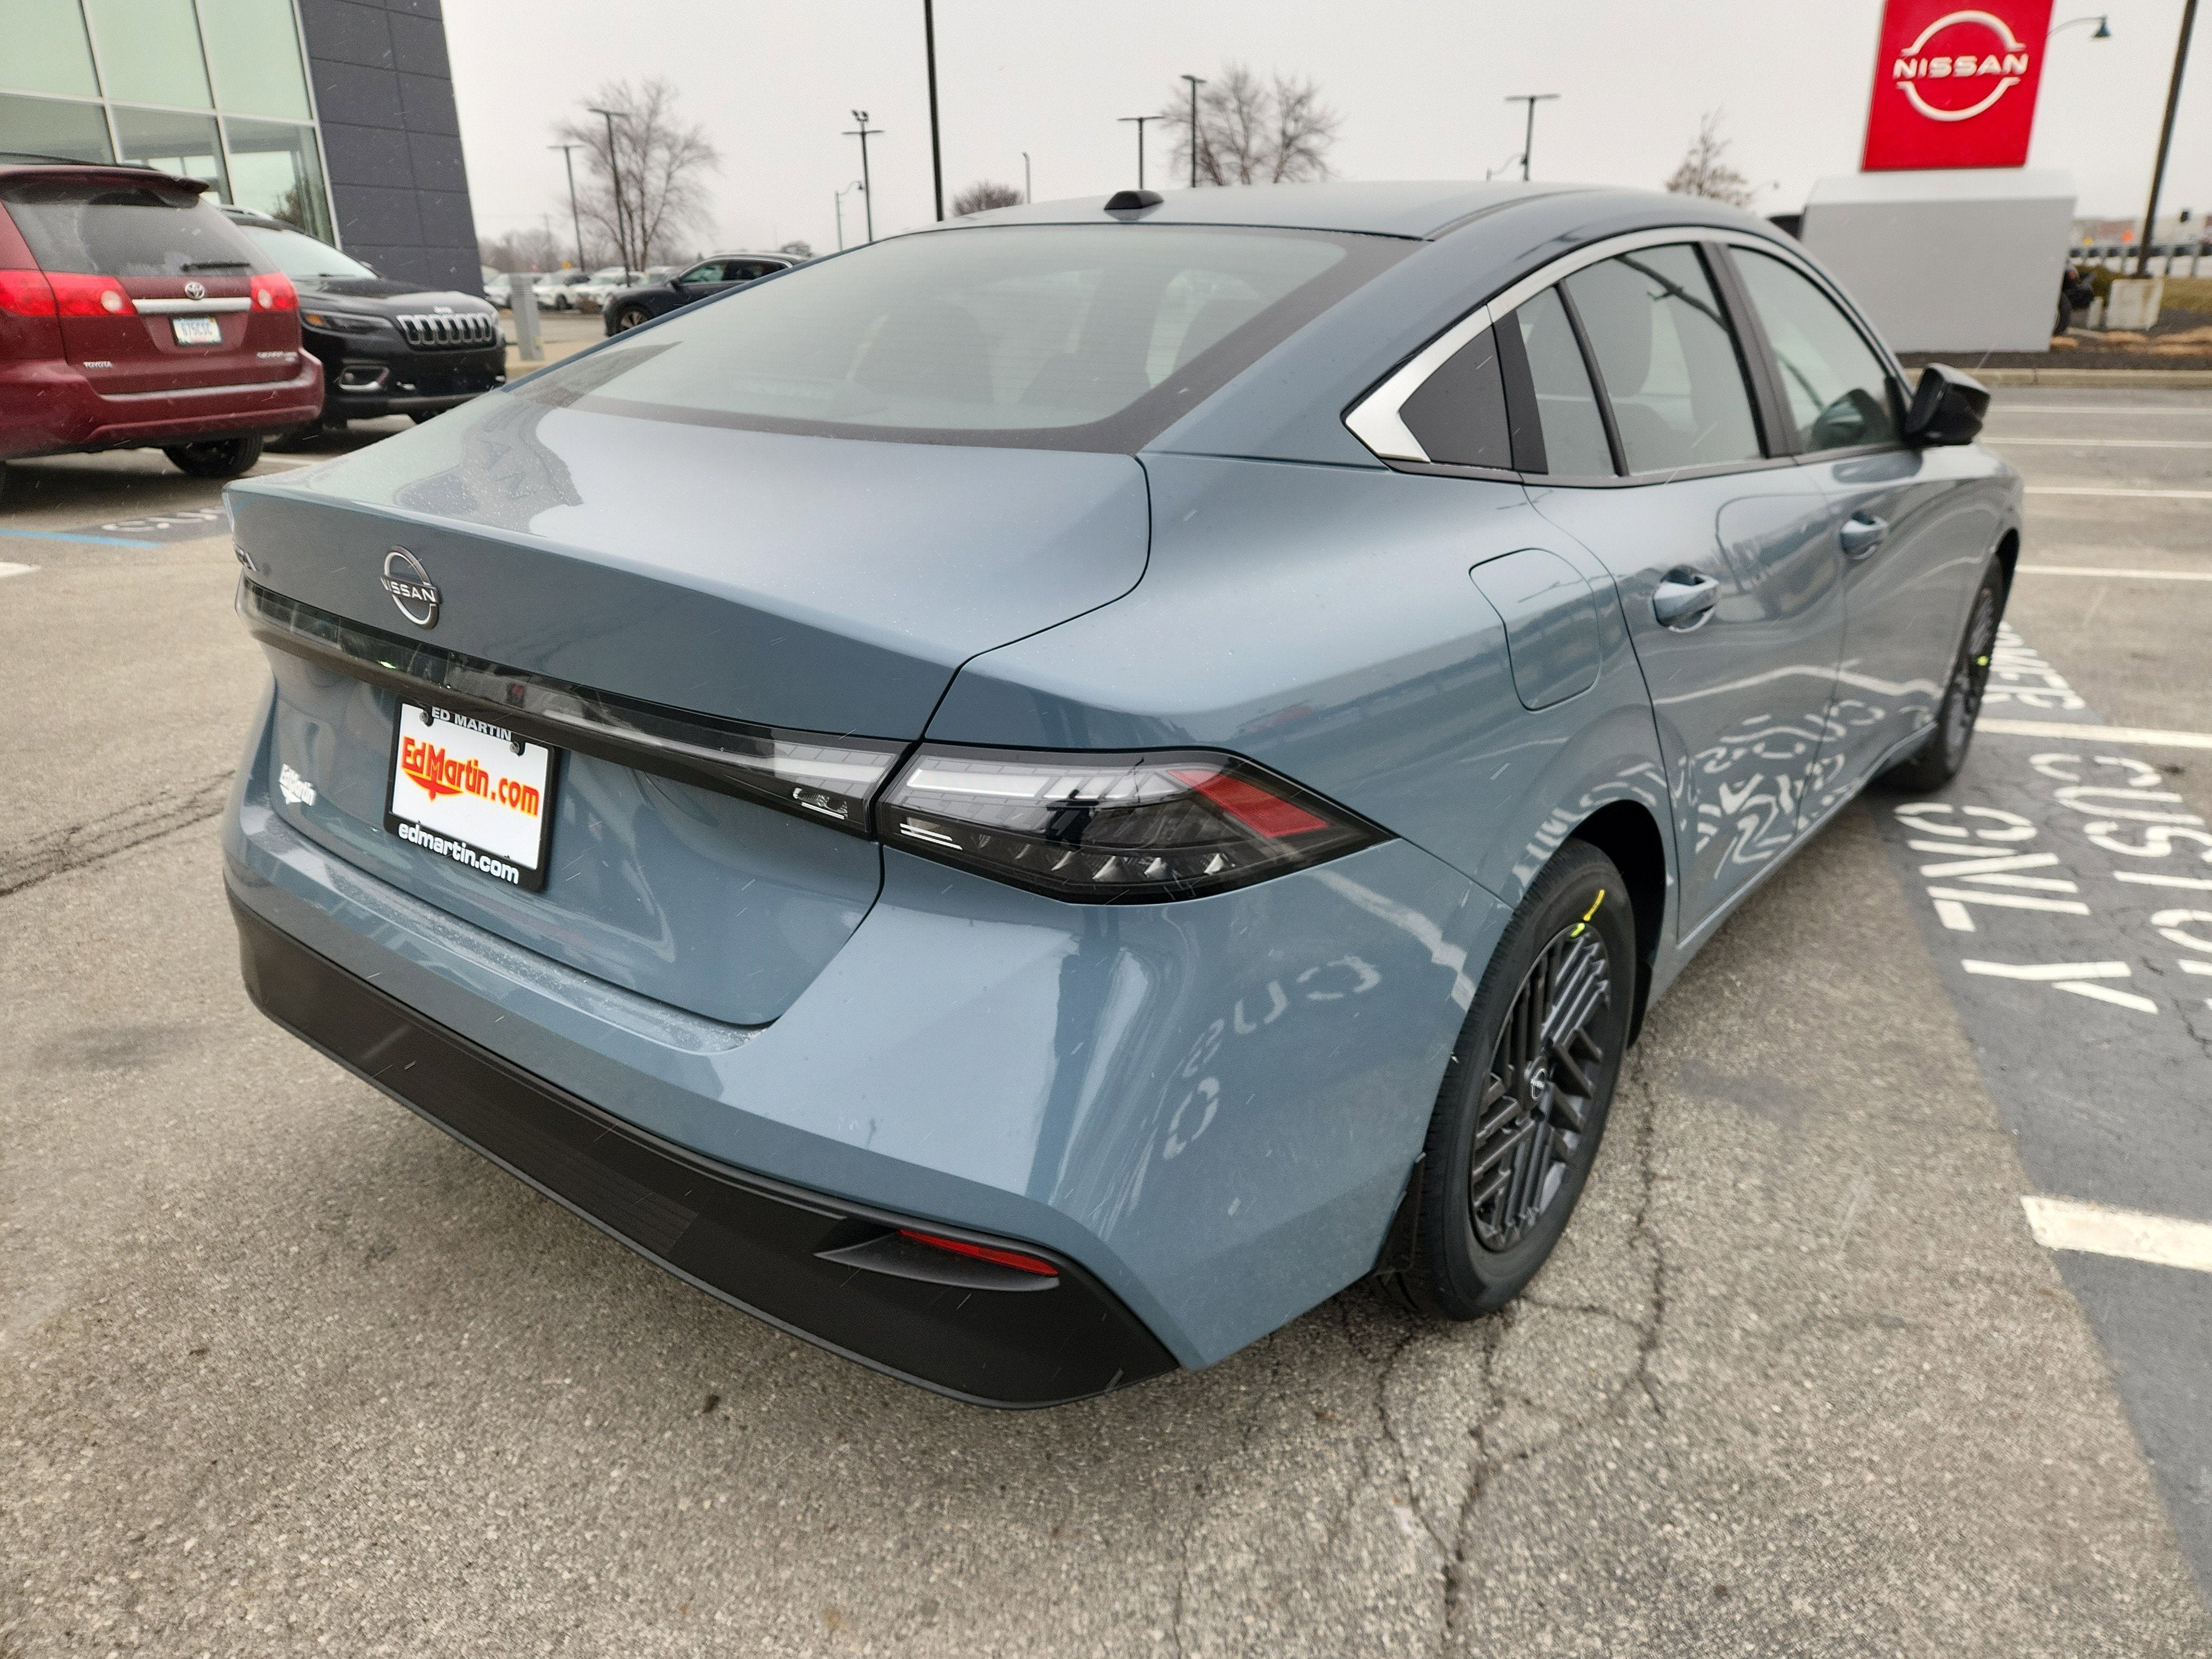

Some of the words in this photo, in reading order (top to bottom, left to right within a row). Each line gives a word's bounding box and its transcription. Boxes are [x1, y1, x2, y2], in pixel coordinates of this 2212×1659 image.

[1892, 53, 2029, 80] NISSAN
[380, 577, 436, 603] NISSAN
[432, 706, 451, 722] ED
[454, 713, 512, 742] MARTIN
[398, 822, 519, 885] edmartin.com
[1893, 802, 2159, 1014] ONLY
